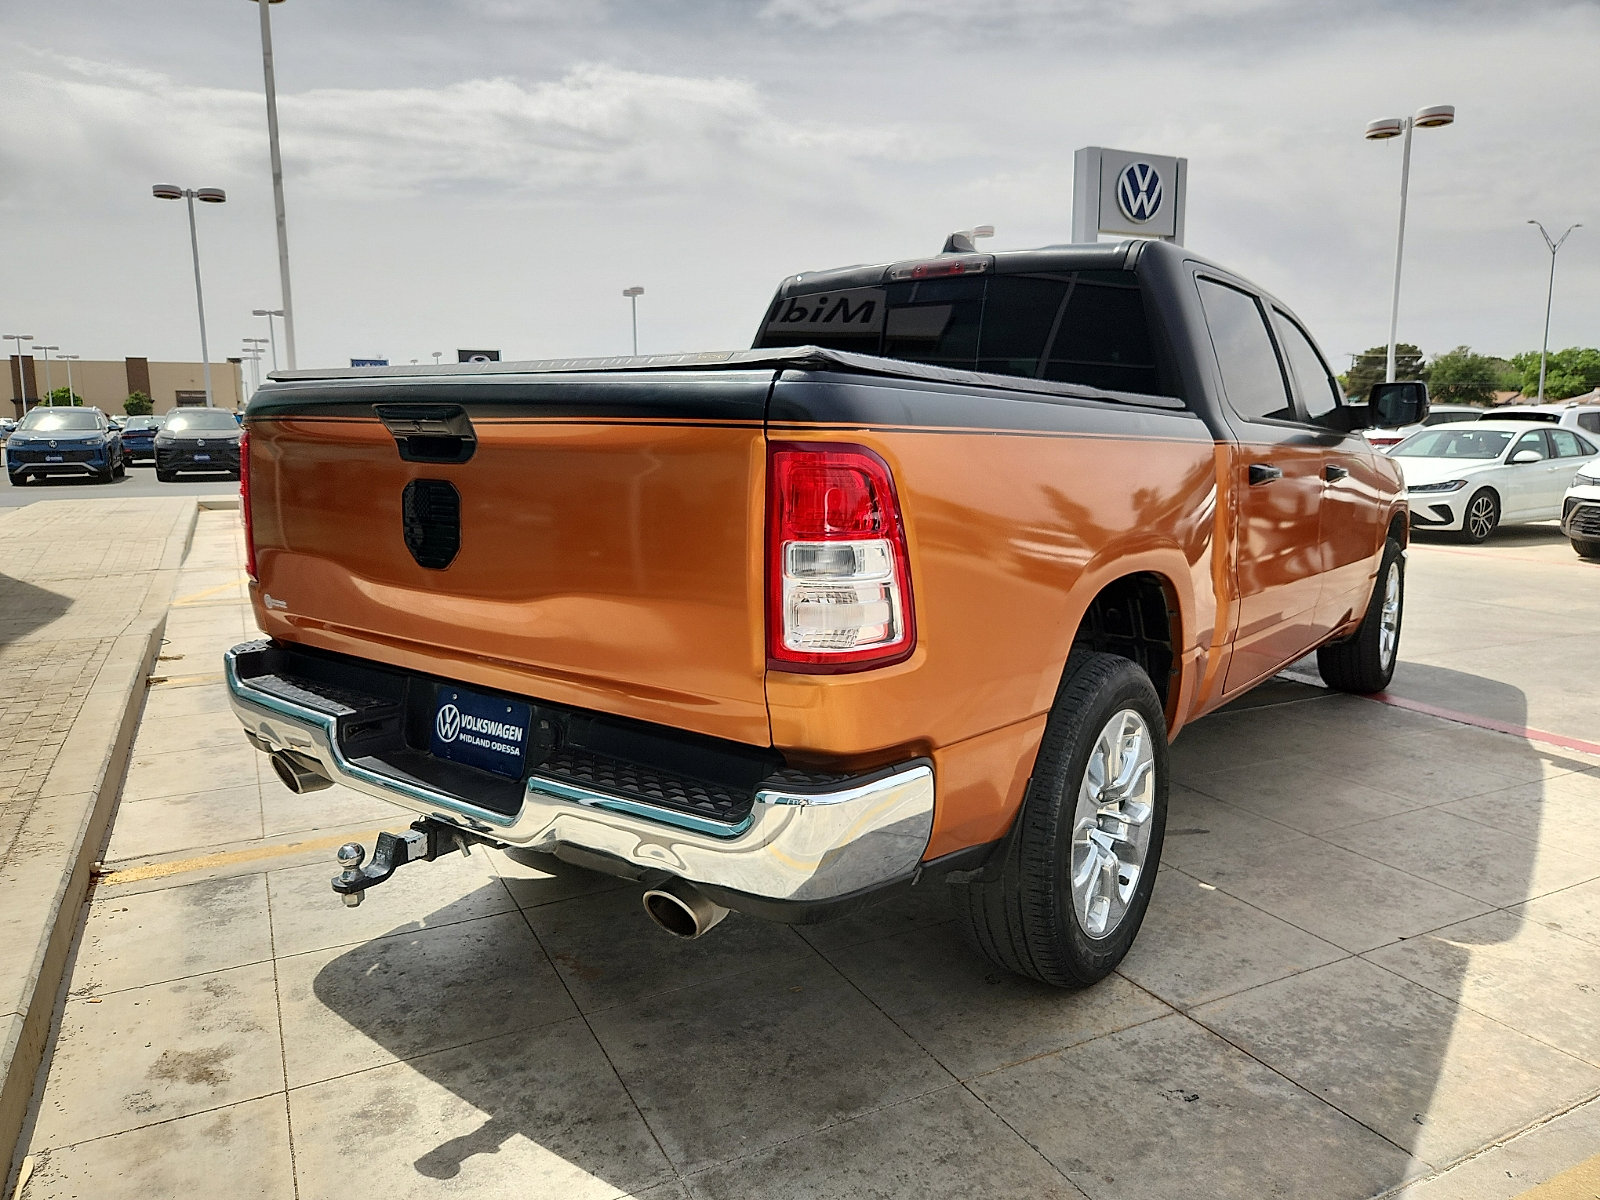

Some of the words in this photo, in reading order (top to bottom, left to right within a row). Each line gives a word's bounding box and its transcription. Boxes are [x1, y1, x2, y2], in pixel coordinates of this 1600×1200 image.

[1118, 162, 1163, 224] VW
[461, 713, 523, 742] VOLKSWAGEN
[459, 732, 491, 748] MIDLAND
[491, 742, 521, 756] ODESSA
